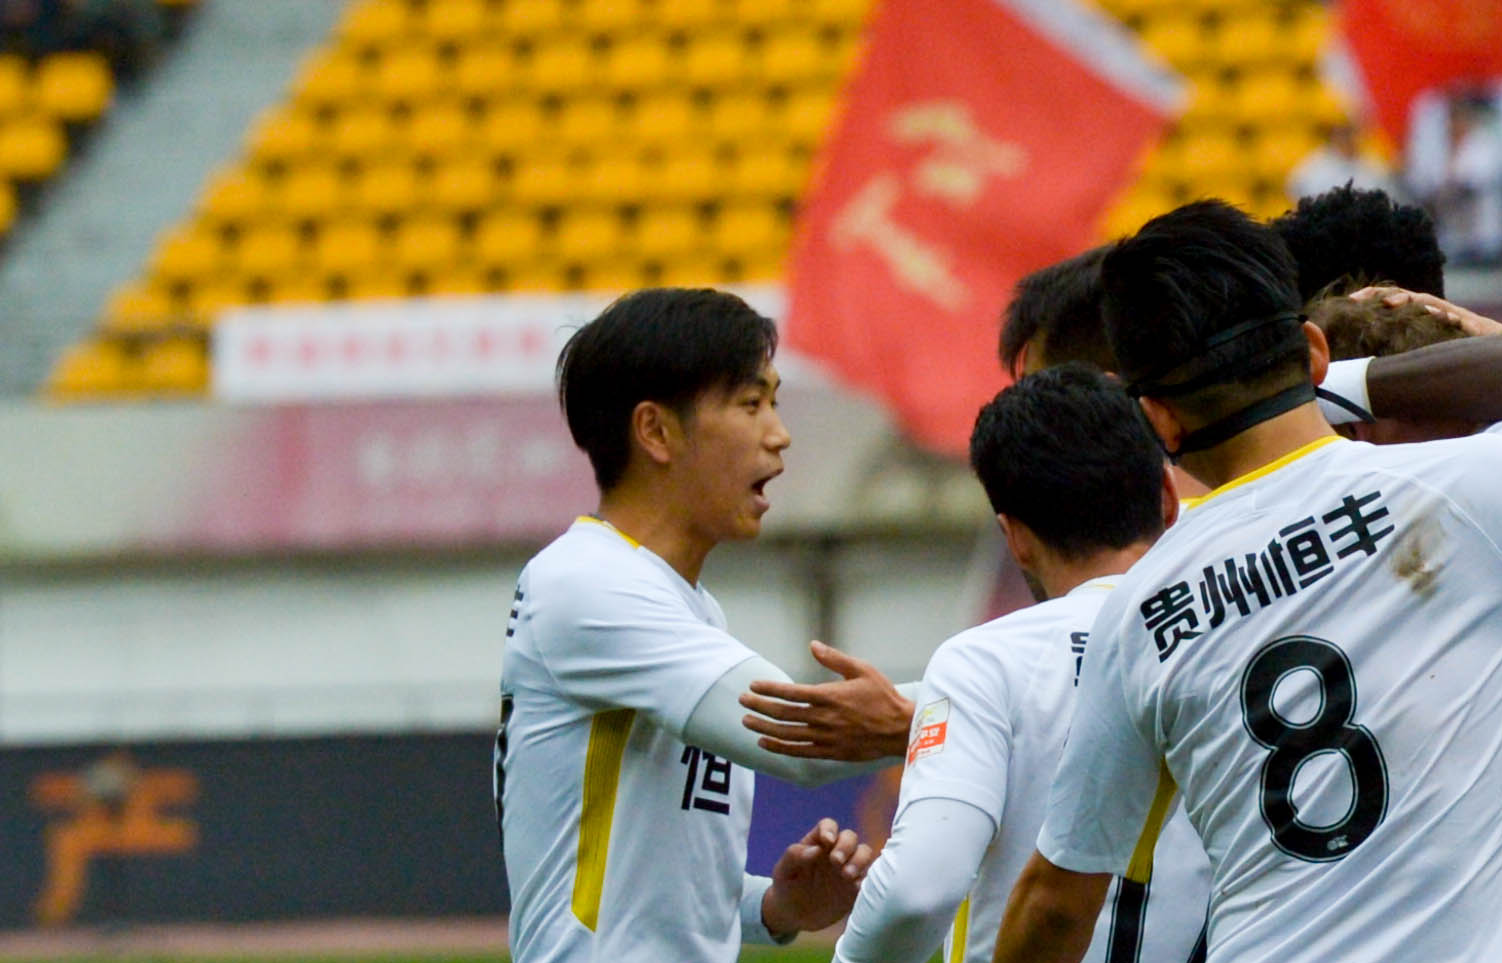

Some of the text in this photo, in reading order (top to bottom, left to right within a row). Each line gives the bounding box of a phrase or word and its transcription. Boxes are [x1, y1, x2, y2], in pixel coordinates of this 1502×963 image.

[1139, 490, 1395, 663] 贵州恒丰
[1239, 634, 1390, 863] 8
